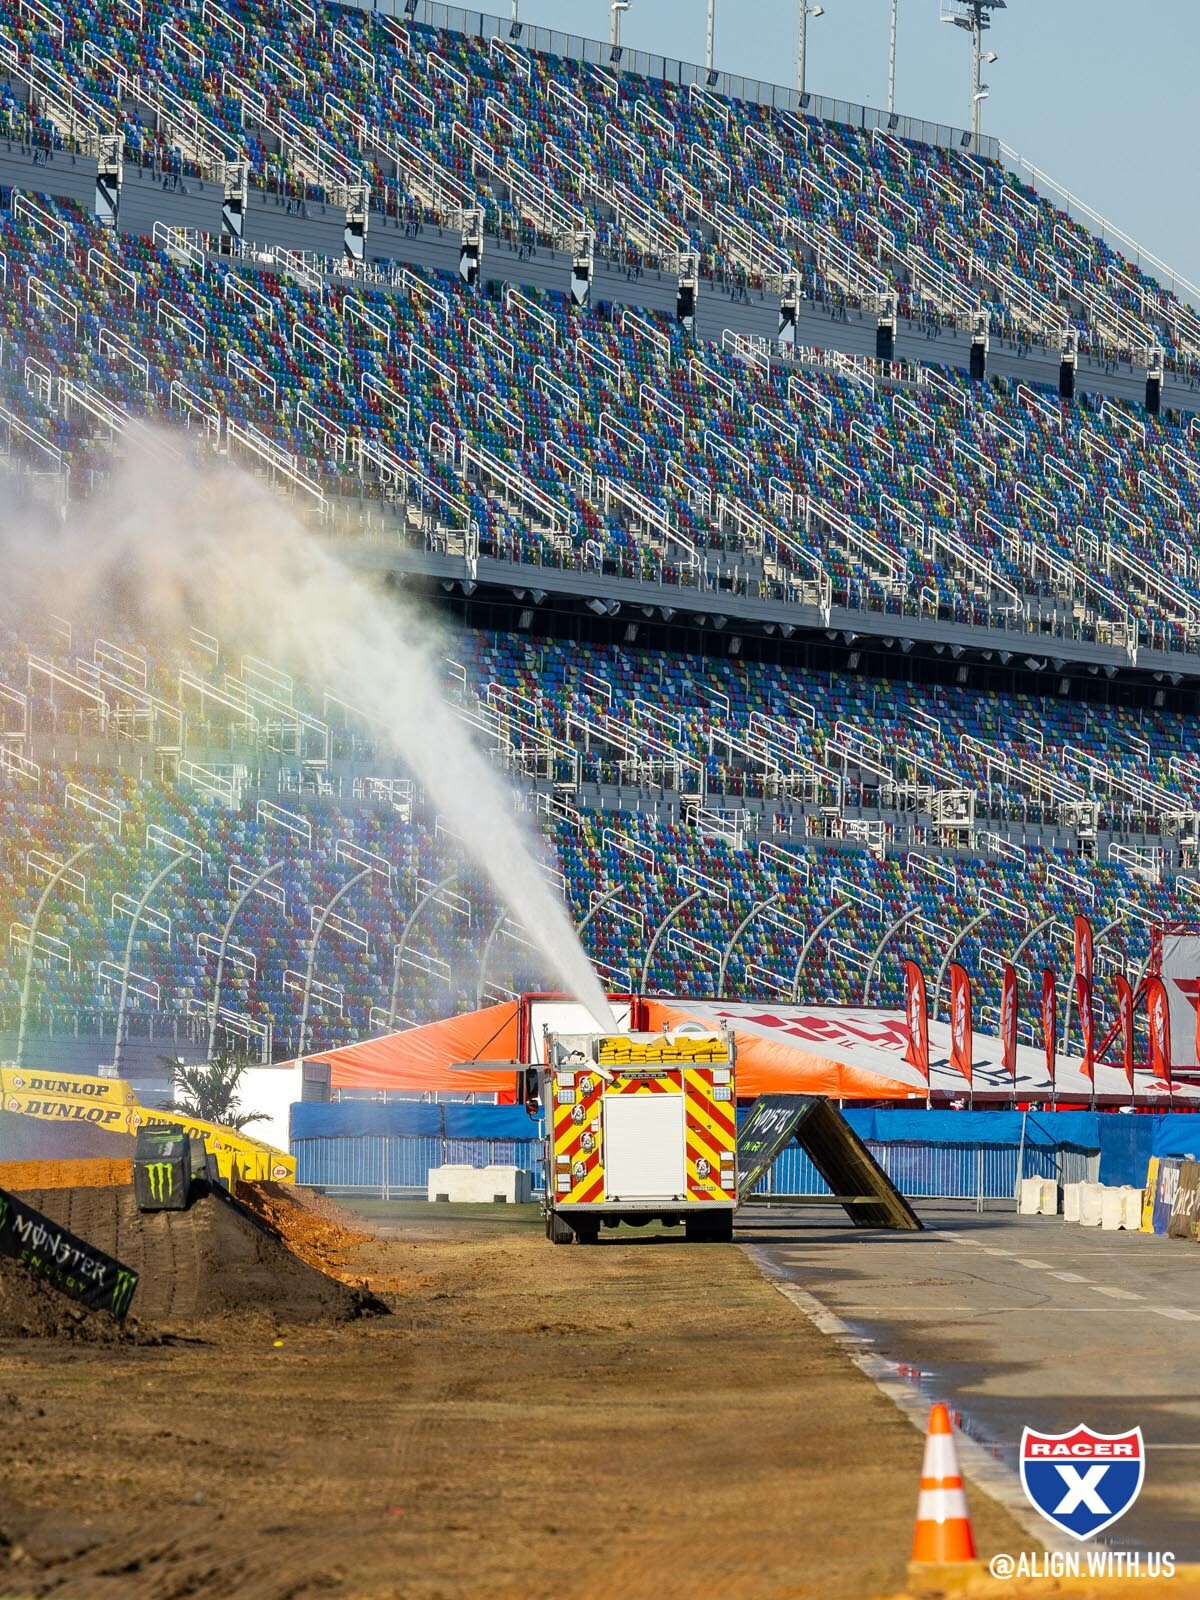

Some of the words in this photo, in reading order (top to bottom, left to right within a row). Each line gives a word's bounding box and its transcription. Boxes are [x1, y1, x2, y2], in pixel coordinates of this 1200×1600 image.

[29, 1078, 110, 1096] DUNLOP
[24, 1100, 122, 1124] DUNLOP
[12, 1215, 109, 1287] MONSTER
